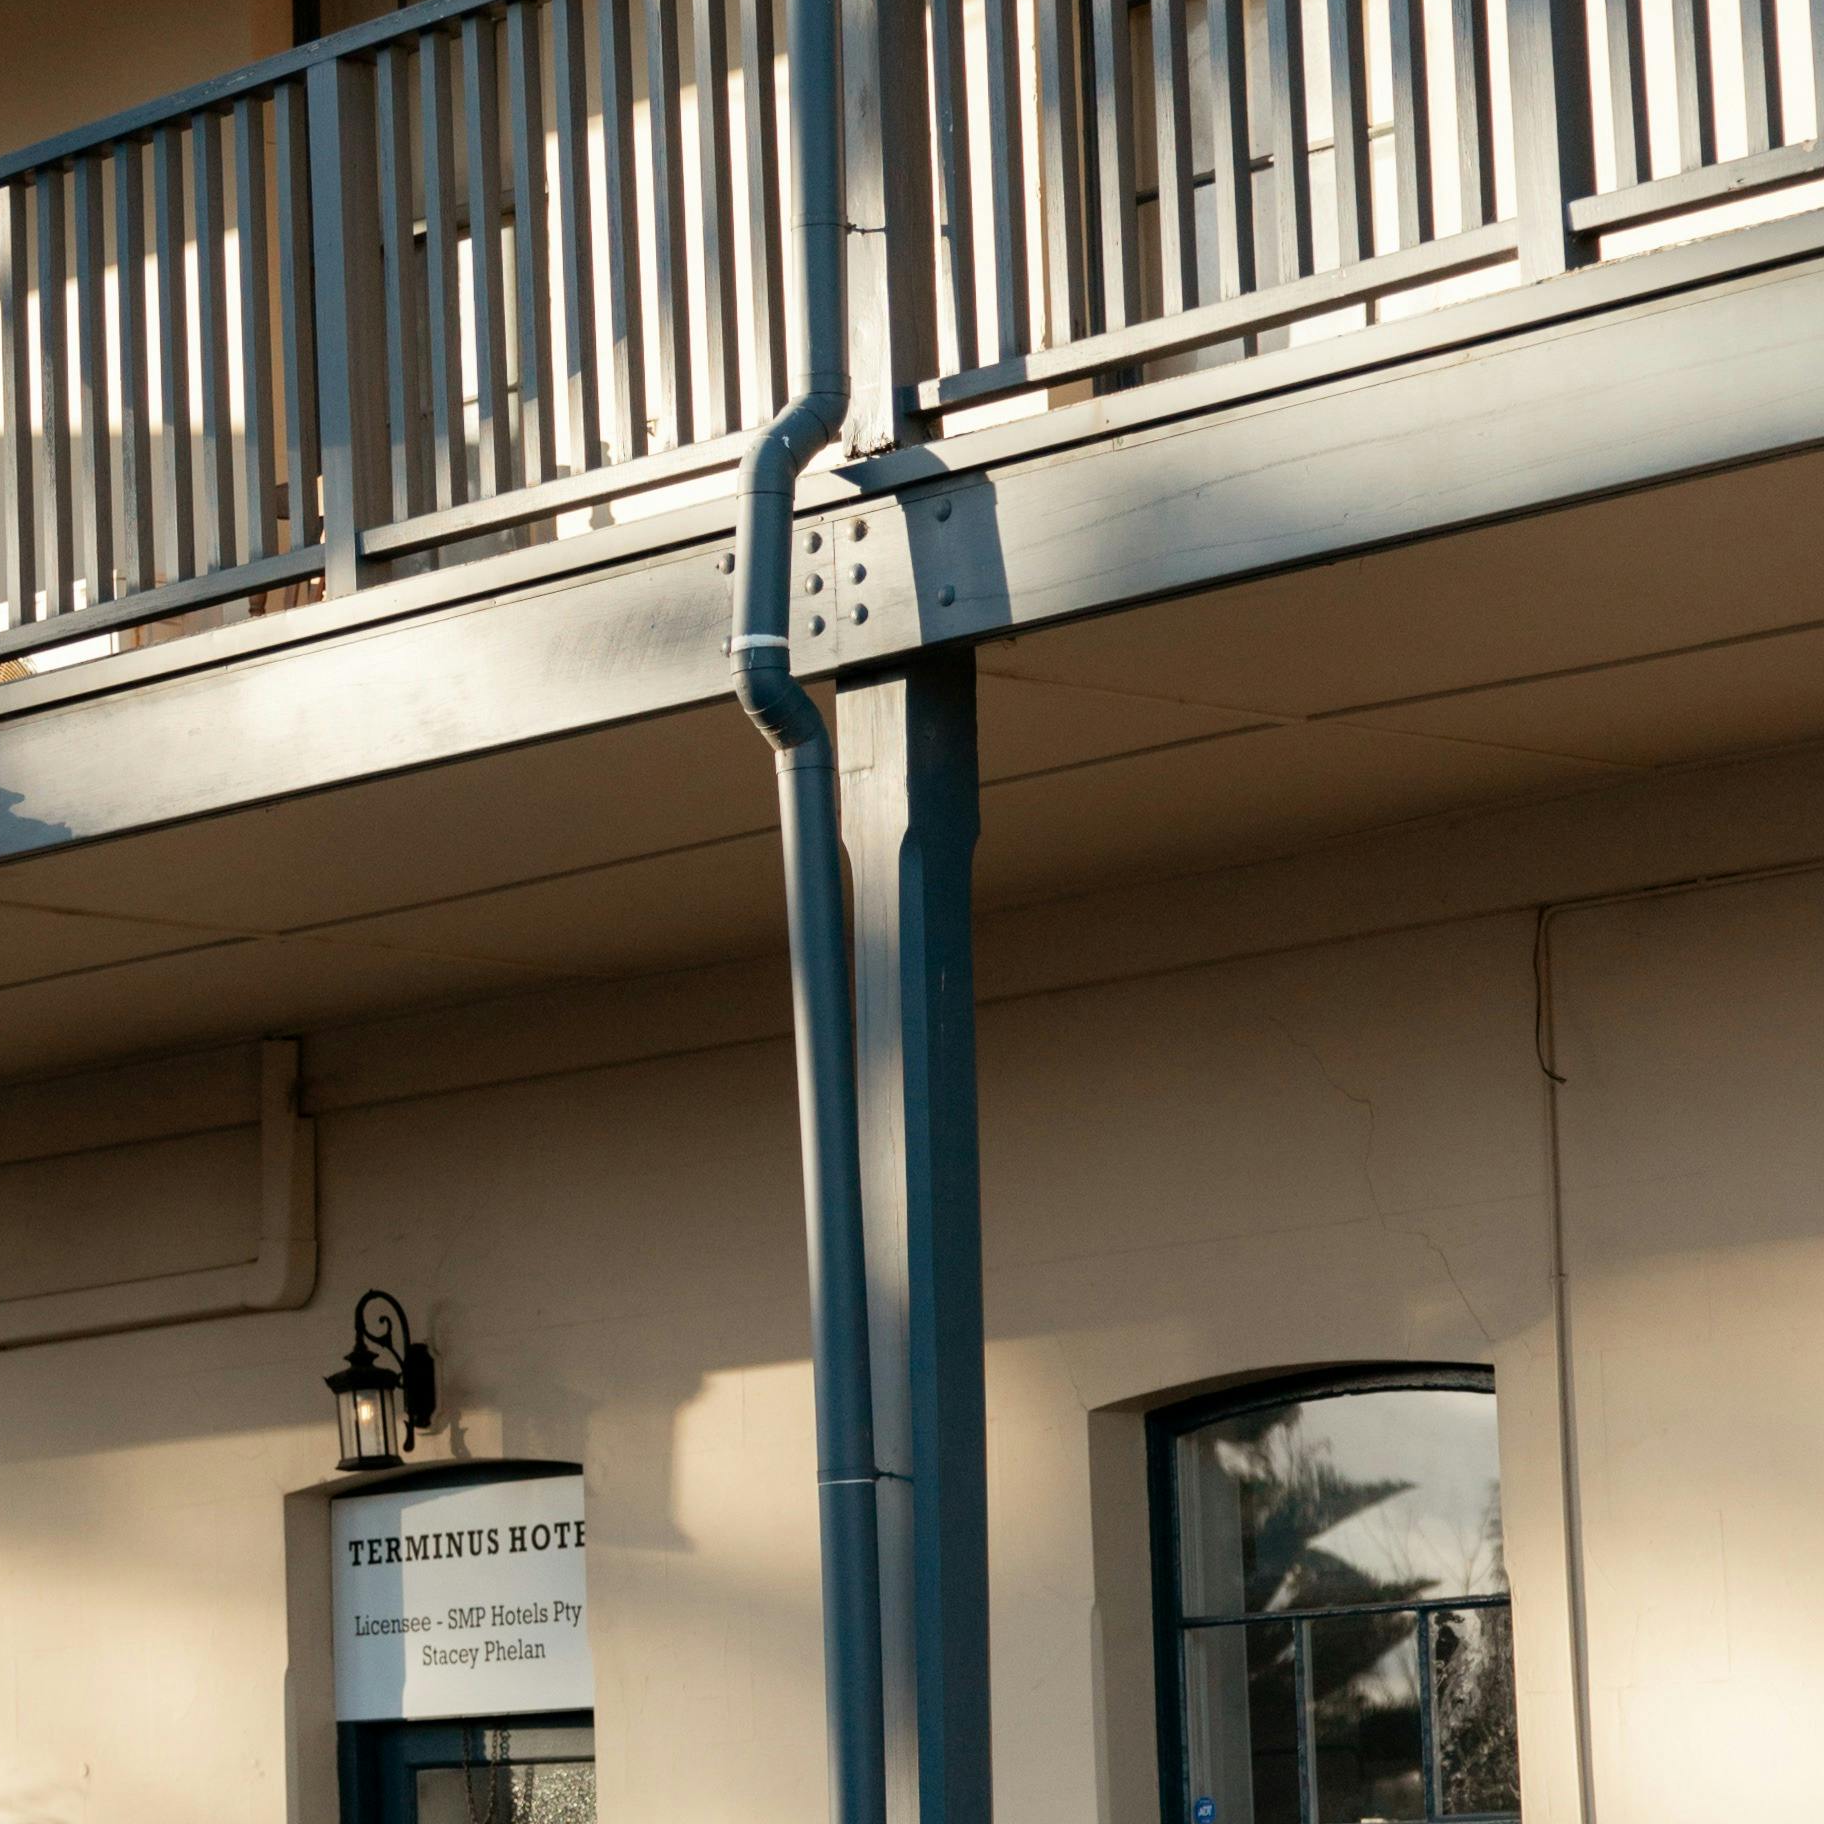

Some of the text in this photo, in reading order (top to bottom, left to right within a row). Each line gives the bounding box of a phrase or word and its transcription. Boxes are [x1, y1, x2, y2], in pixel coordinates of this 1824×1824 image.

[349, 1529, 500, 1567] TERMINUS
[354, 1614, 432, 1638] Licensee
[448, 1606, 486, 1631] SMP
[491, 1602, 549, 1627] Hotels
[553, 1600, 583, 1626] Pty
[422, 1638, 546, 1669] Stacey Phelan
